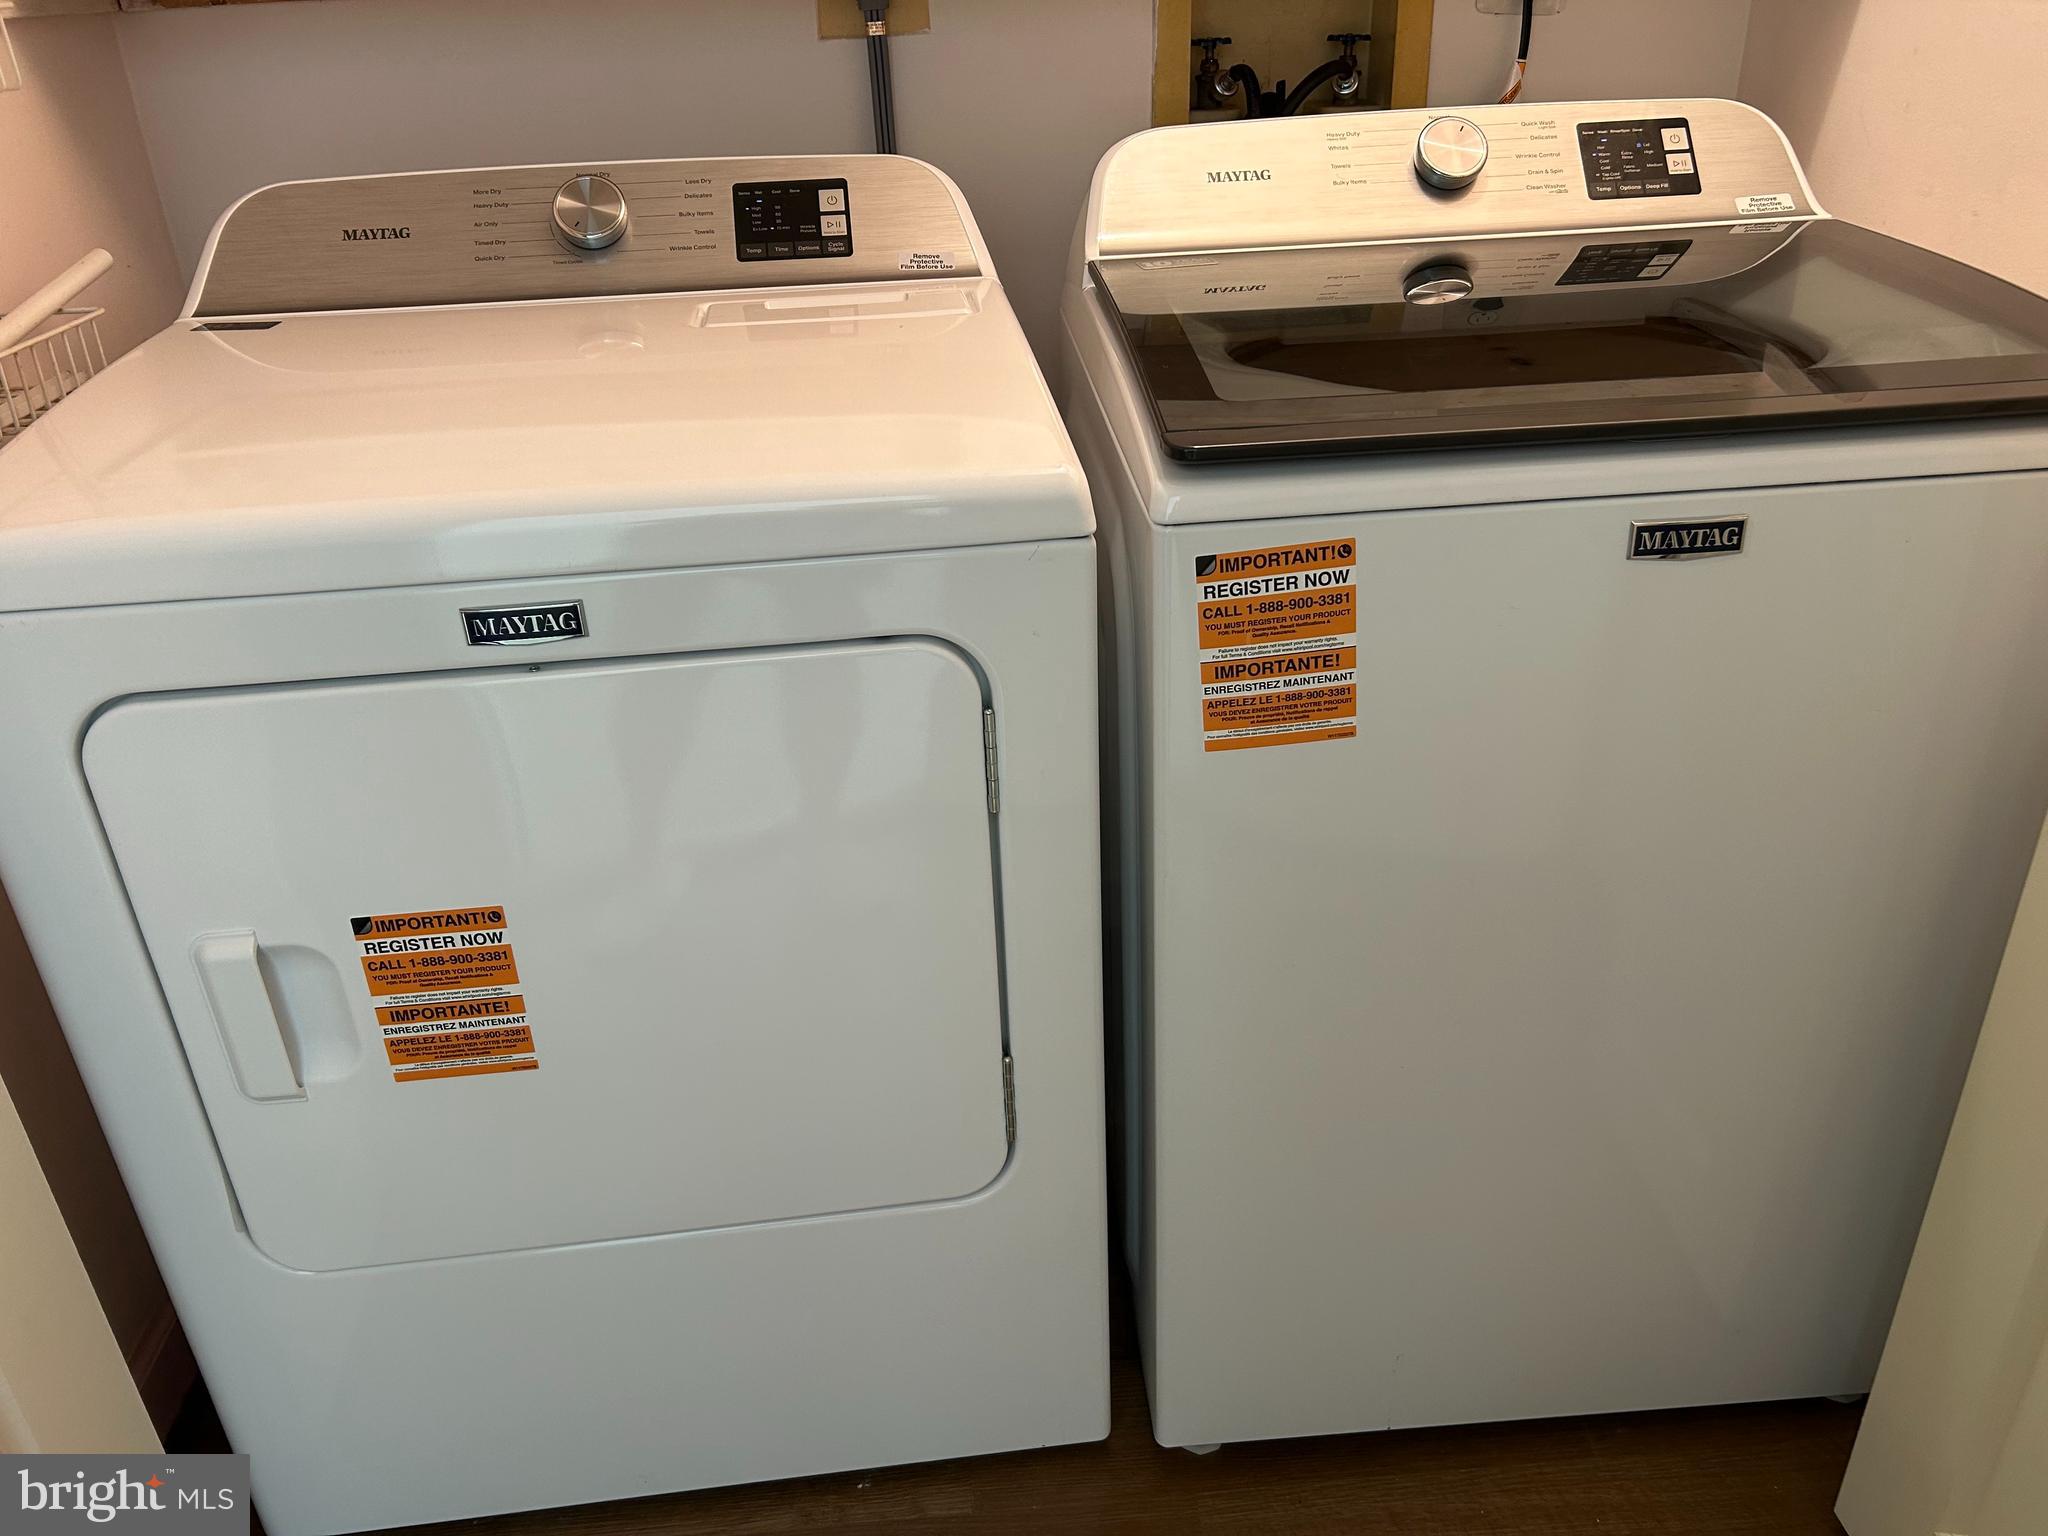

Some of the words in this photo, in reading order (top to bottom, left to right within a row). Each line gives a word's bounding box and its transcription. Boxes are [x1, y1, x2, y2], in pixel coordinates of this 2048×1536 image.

[1207, 169, 1271, 183] MAYTAG
[1620, 184, 1641, 192] Options
[342, 227, 411, 241] MAYTAG
[1638, 527, 1738, 551] MAYTAG
[1219, 545, 1335, 574] IMPORTANT!
[1203, 576, 1299, 600] REGISTER
[1304, 569, 1350, 589] NOW
[1203, 606, 1242, 620] CALL
[1246, 592, 1350, 615] 1-888-900-3381
[471, 612, 578, 637] MAYTAG
[1224, 621, 1246, 629] MUST
[1248, 617, 1287, 627] REGISTER
[1289, 613, 1311, 622] YOUR
[1313, 609, 1351, 619] PRODUCT
[1214, 654, 1340, 680] IMPORTANTE!
[1203, 680, 1280, 695] ENREGISTREZ
[1283, 671, 1354, 688] MAINTENANT
[1207, 697, 1256, 709] APPELEZ
[1259, 695, 1273, 704] LE
[1276, 686, 1351, 703] 1-888-900-3381
[1229, 708, 1250, 716] DEVEZ
[1251, 703, 1298, 713] ENREGISTRER
[1299, 701, 1322, 709] VOTRE
[1323, 697, 1353, 706] PRODUIT
[374, 912, 487, 933] IMPORTANT!
[364, 936, 456, 954] REGISTER
[460, 931, 503, 946] NOW
[368, 960, 406, 971] CALL
[409, 951, 508, 968] 1-888-900-3381
[413, 969, 451, 978] REGISTER
[452, 967, 474, 975] YOUR
[475, 964, 512, 973] PRODUCT
[390, 1001, 510, 1022] IMPORTANTE!
[383, 1023, 457, 1035] ENREGISTREZ
[459, 1016, 526, 1029] MAINTENANT
[390, 1037, 437, 1047] APPELEZ
[439, 1035, 453, 1043] LE
[455, 1029, 526, 1041] 1-888-900-3381
